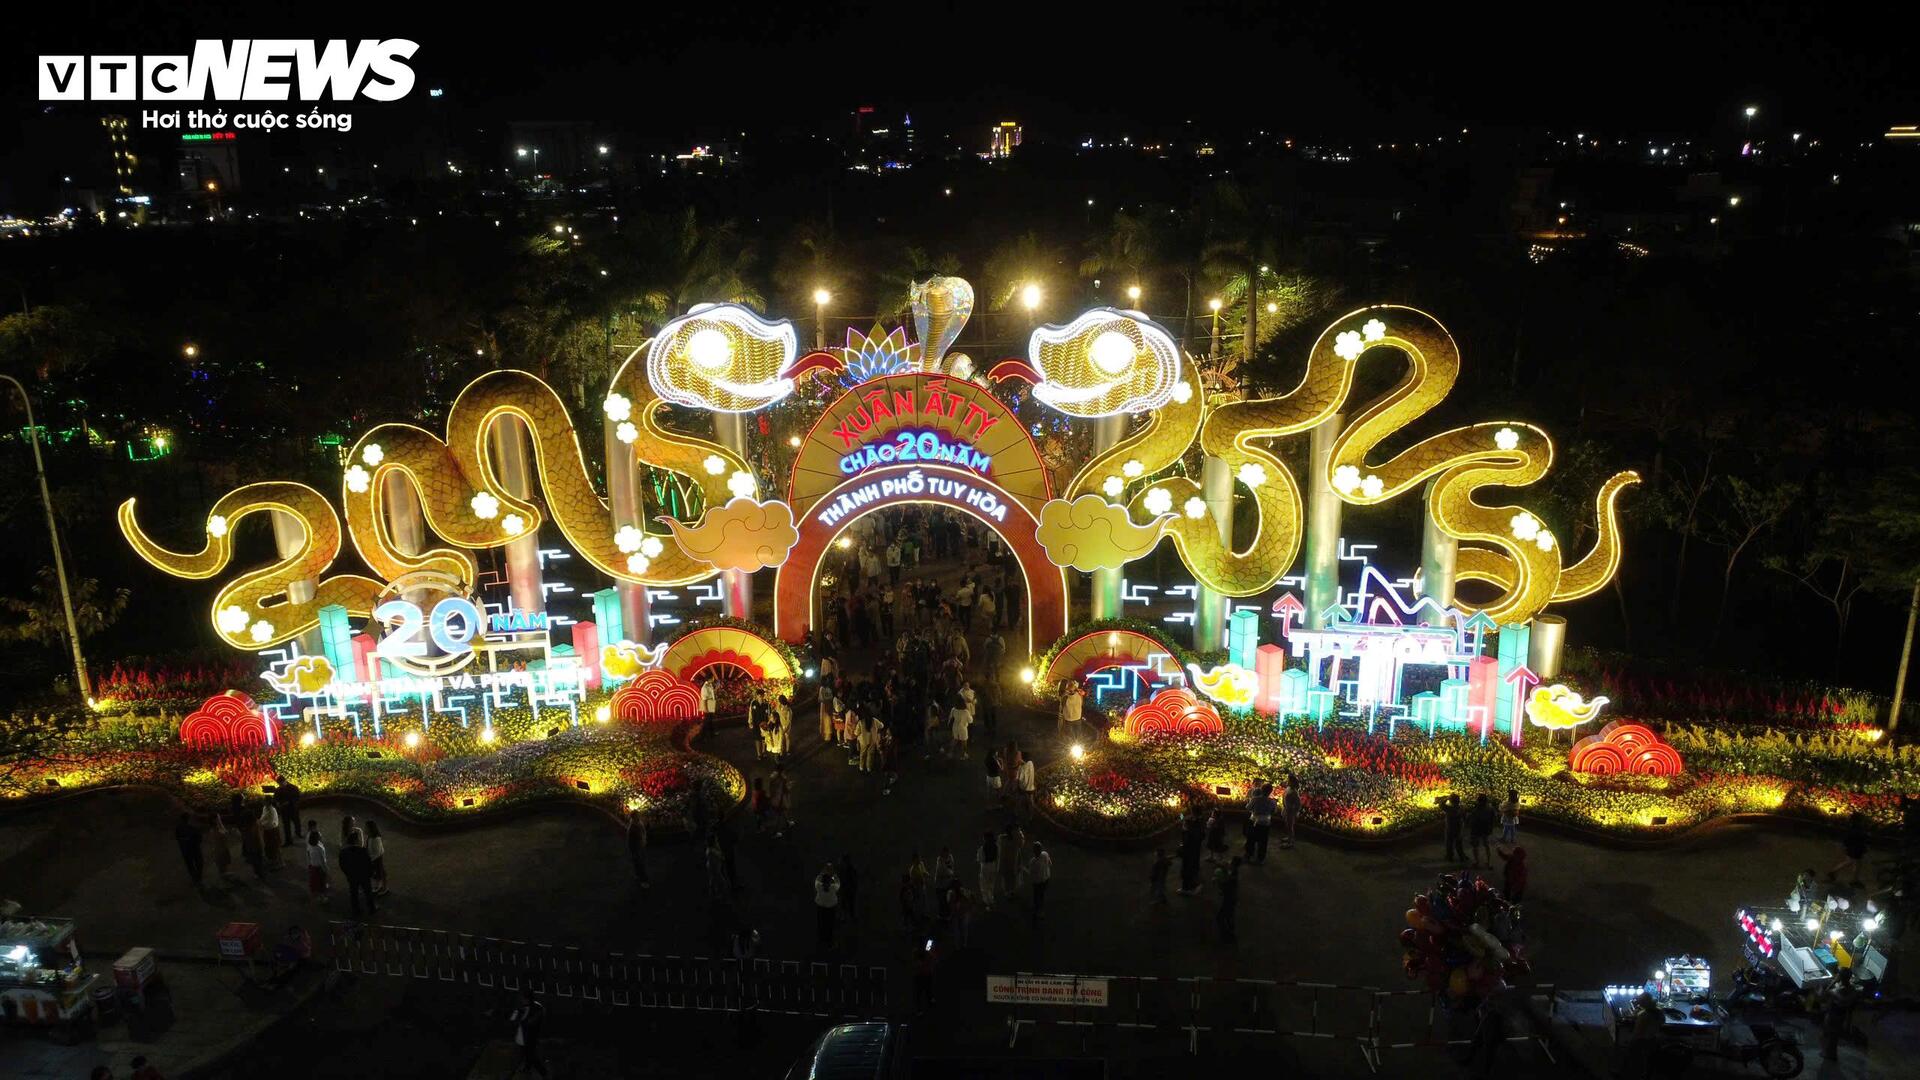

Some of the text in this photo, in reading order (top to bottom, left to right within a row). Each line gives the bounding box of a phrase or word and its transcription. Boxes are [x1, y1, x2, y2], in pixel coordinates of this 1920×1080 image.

[832, 389, 914, 448] XUÂN
[924, 379, 965, 418] ẤT
[896, 431, 940, 460] 20
[941, 443, 993, 473] NĂM
[818, 470, 1008, 527] THÀNH PHỐ TUY HÒA
[374, 597, 548, 657] 20 NĂM
